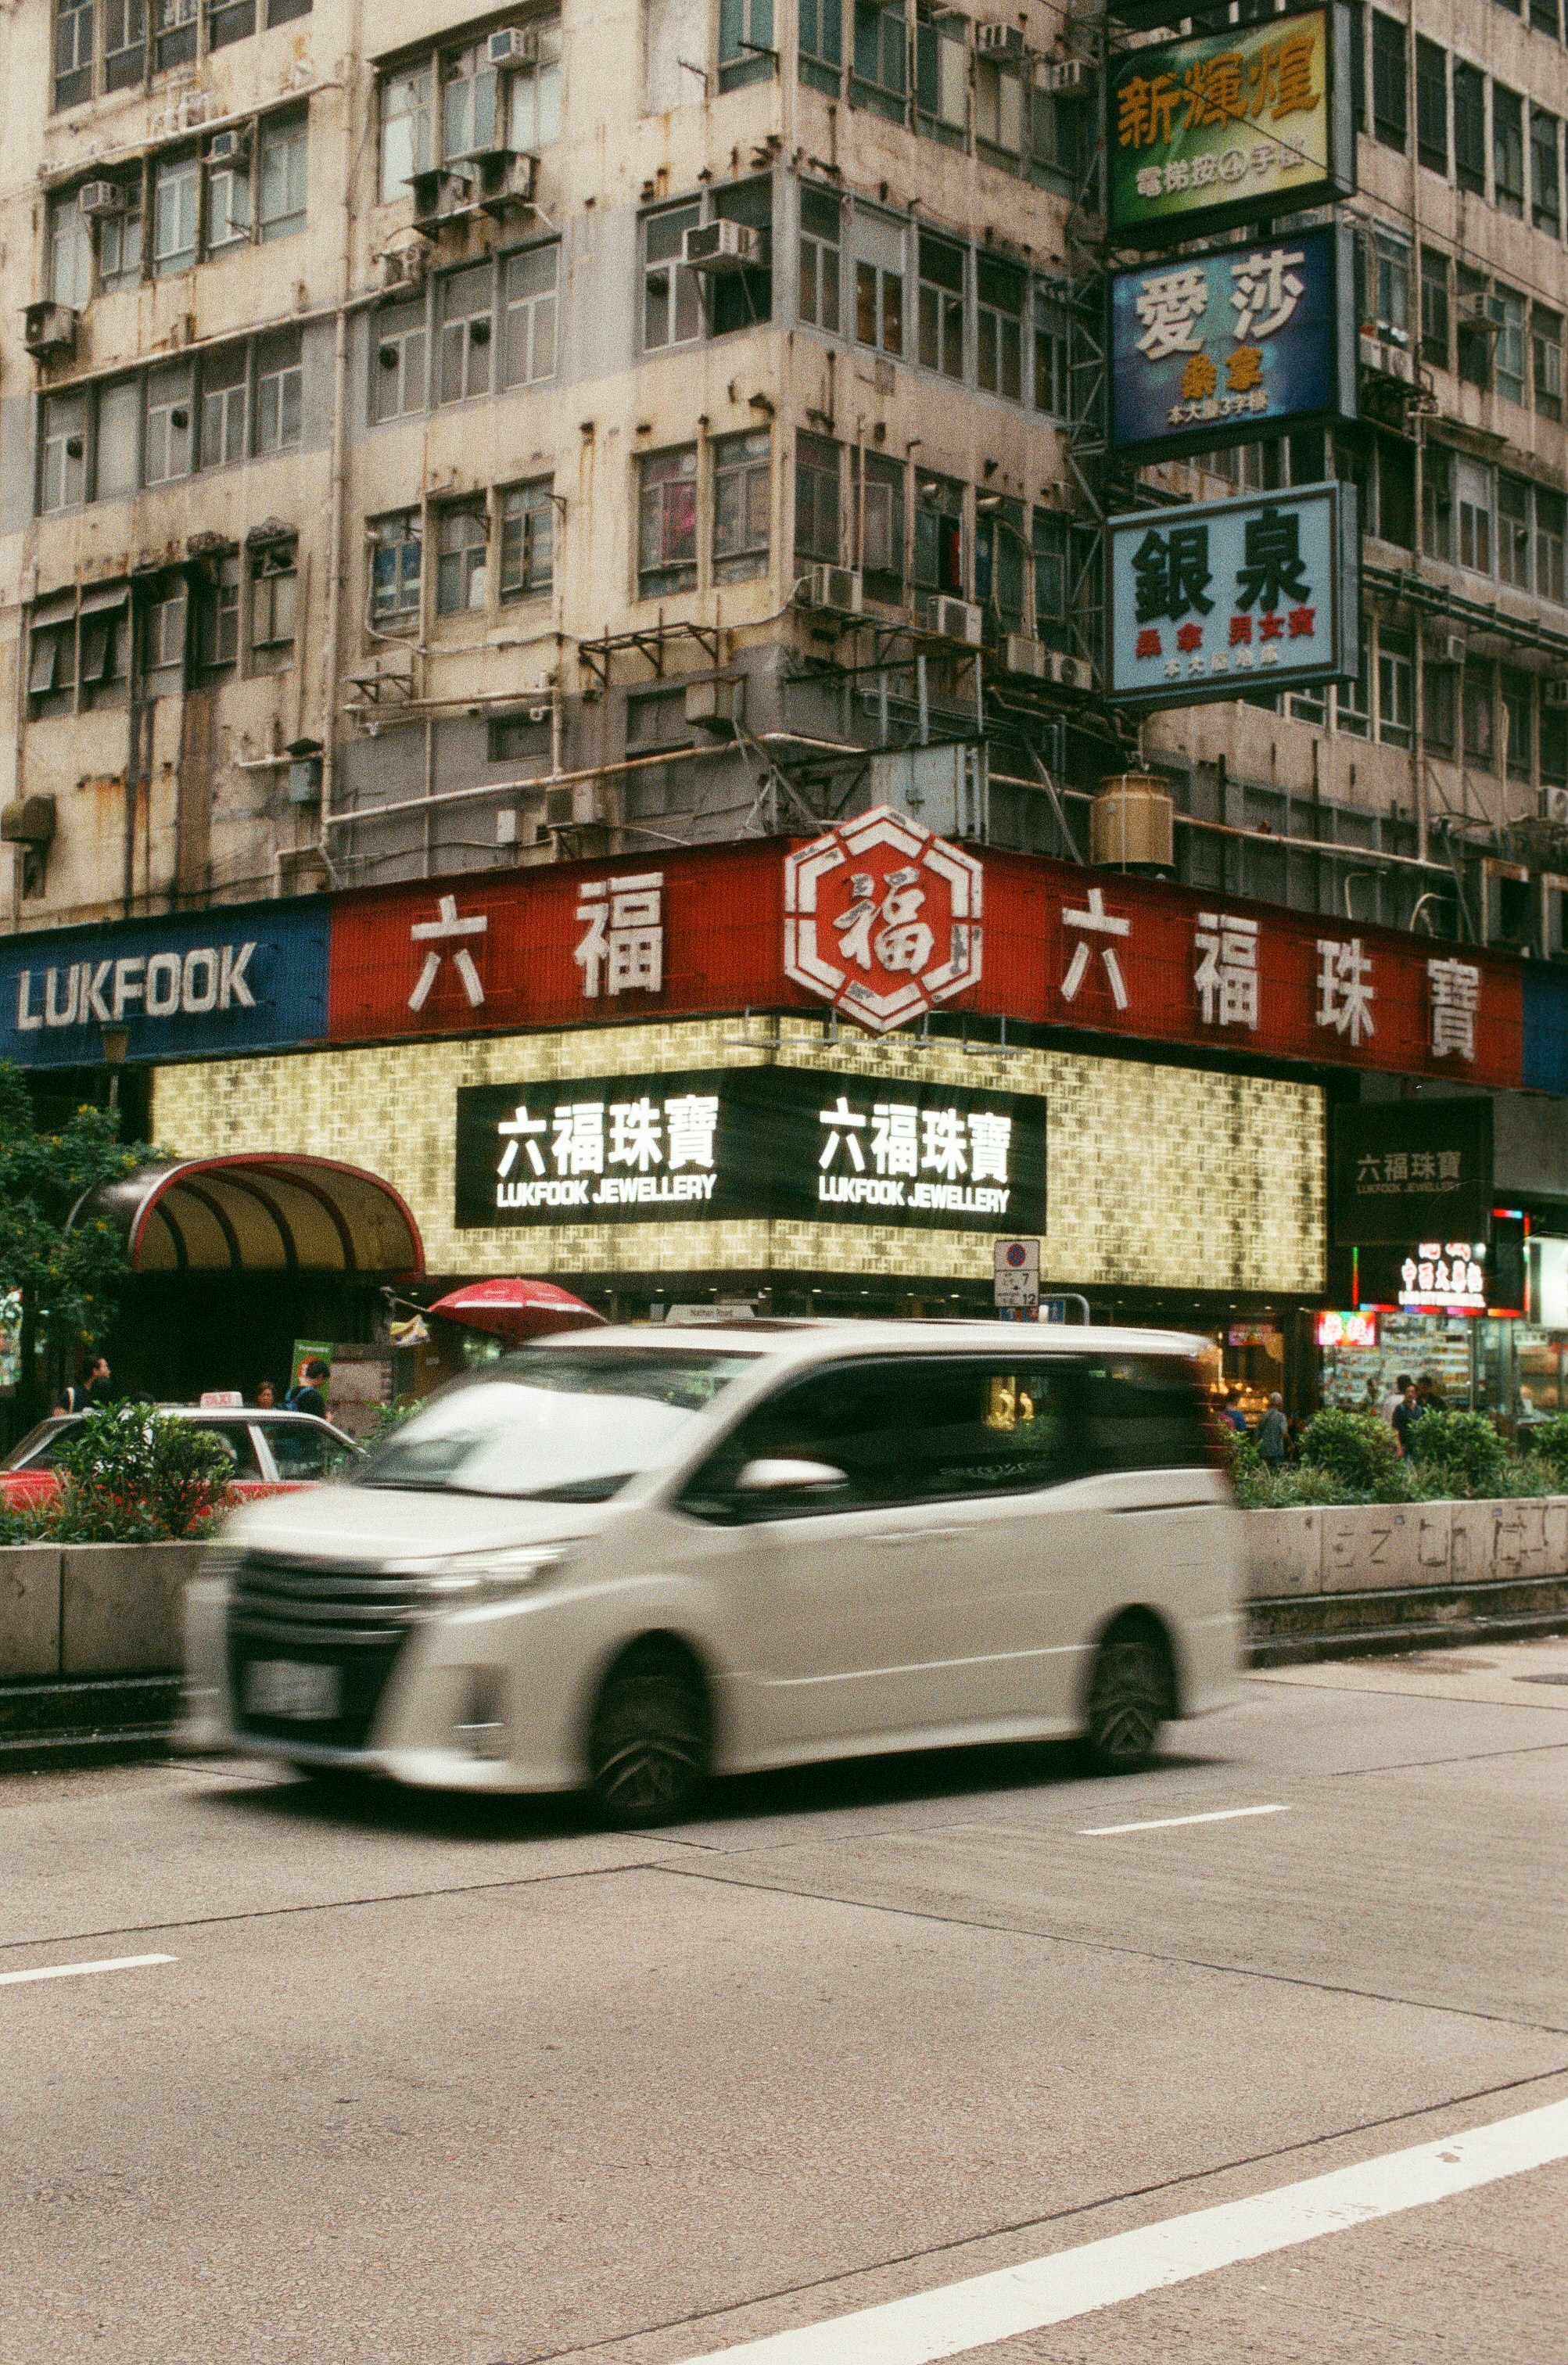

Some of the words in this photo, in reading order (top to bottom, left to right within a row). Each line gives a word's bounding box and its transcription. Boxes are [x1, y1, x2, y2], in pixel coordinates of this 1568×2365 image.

[1117, 34, 1321, 149] 新輝煌
[1135, 249, 1304, 360] 愛莎
[1132, 508, 1311, 623] 銀泉
[408, 872, 664, 1011] 六福
[833, 867, 935, 975] 福
[17, 942, 257, 1030] LUKFOOK
[1060, 887, 1480, 1064] 六福珠寶
[497, 1095, 719, 1178] 六福珠寶
[819, 1097, 1011, 1184] 六福珠寶
[1357, 1150, 1462, 1181] 六福珠寶
[497, 1180, 590, 1208] LUKFOOK
[593, 1174, 716, 1204] JEWELLERY
[819, 1175, 905, 1206] LUKFOOK
[908, 1184, 1010, 1214] JEWELLERY
[1022, 1272, 1030, 1286] 7
[1023, 1293, 1036, 1305] 12
